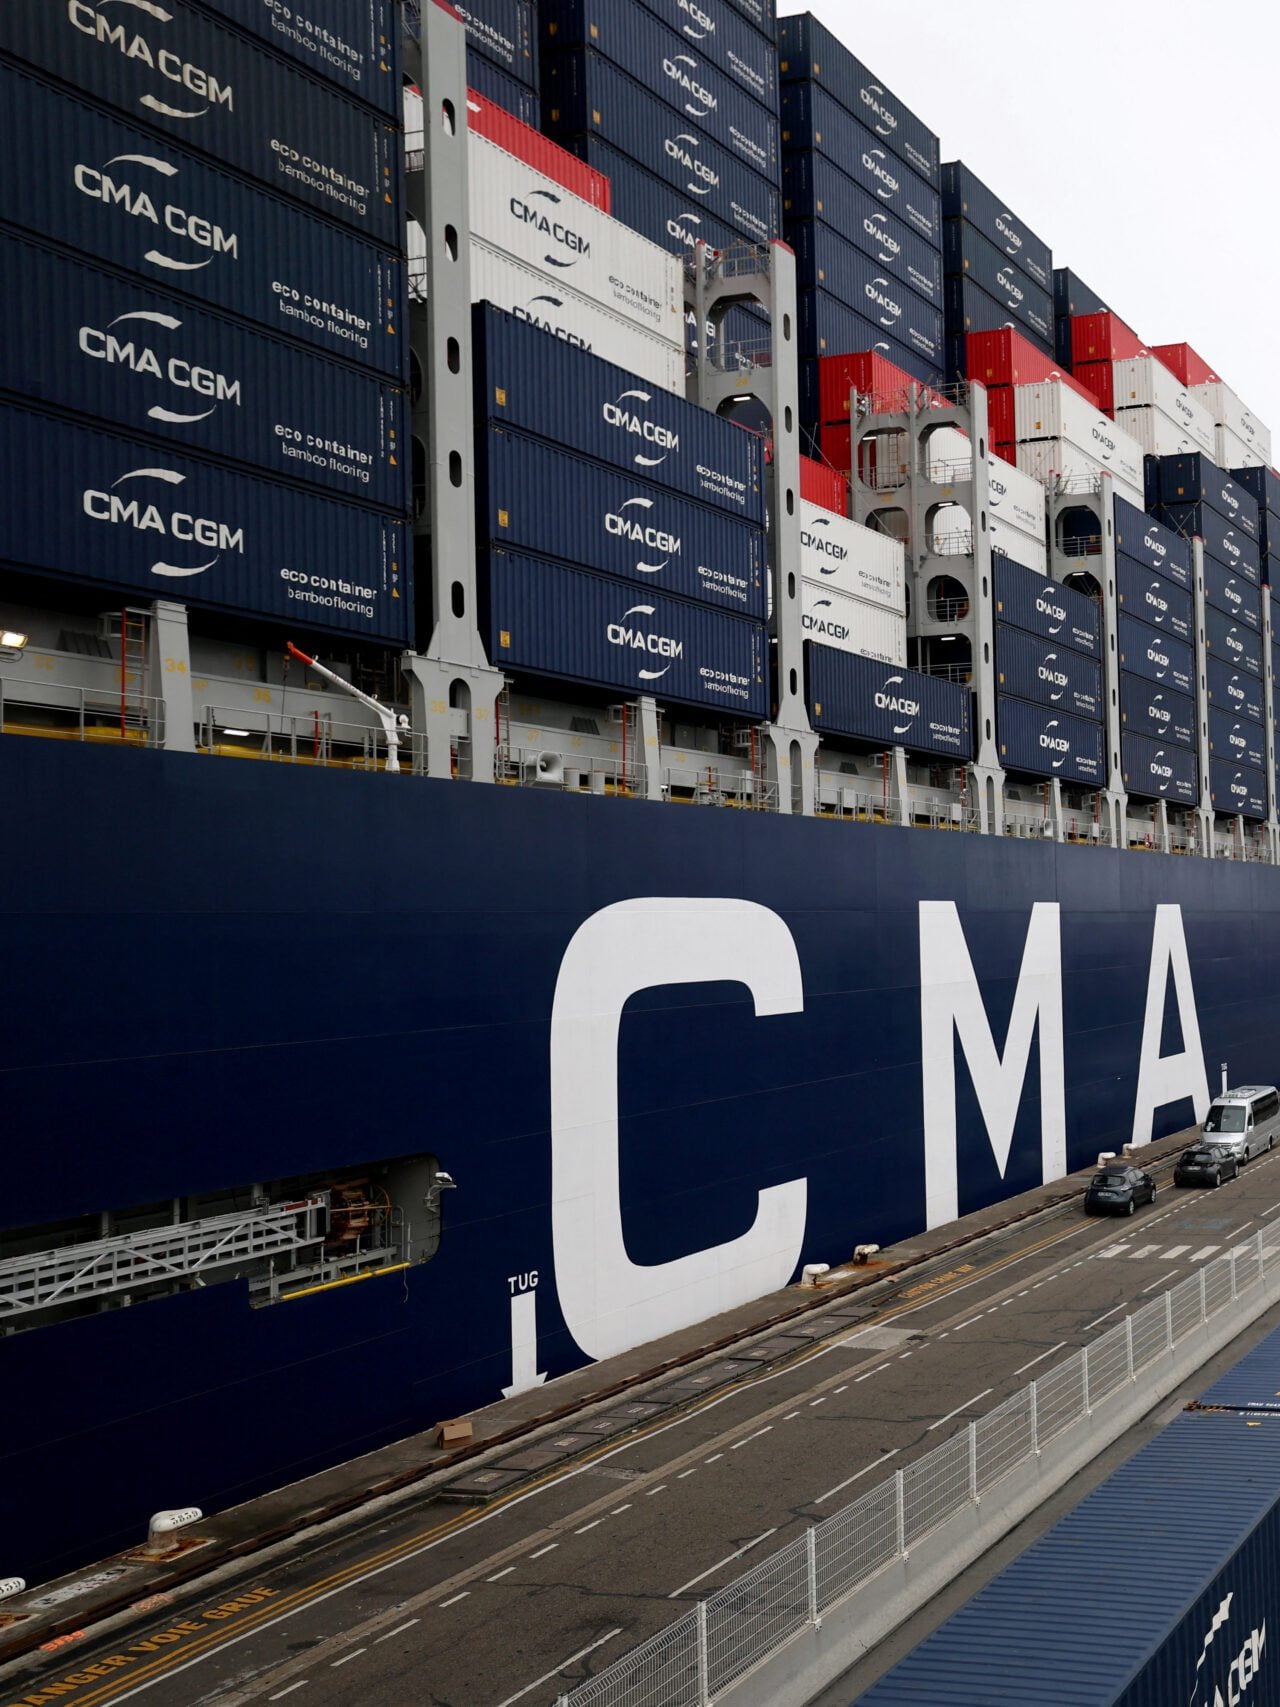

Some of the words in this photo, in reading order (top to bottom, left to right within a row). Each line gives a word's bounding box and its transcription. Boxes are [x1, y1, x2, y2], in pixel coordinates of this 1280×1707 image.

[68, 0, 154, 68] CMA
[158, 50, 233, 112] CGM
[270, 138, 299, 161] eco
[302, 155, 370, 198] container
[278, 159, 324, 193] bamboo
[325, 184, 366, 216] flooring
[74, 164, 158, 224] CMA
[165, 204, 238, 259] CGM
[510, 198, 551, 236] CMA
[553, 216, 590, 259] CGM
[272, 281, 299, 300] eco
[304, 294, 371, 332] container
[280, 300, 324, 329] bamboo
[327, 319, 367, 349] flooring
[79, 327, 162, 379] CMA
[168, 358, 241, 406] CGM
[275, 424, 301, 442] eco
[306, 436, 373, 466] container
[603, 403, 642, 436] CMA
[643, 422, 679, 453] CGM
[282, 442, 326, 467] bamboo
[329, 457, 369, 482] flooring
[83, 489, 165, 534] CMA
[171, 514, 244, 554] CGM
[605, 513, 644, 542] CMA
[645, 531, 681, 557] CGM
[801, 531, 825, 555] CMA
[826, 541, 848, 560] CGM
[281, 567, 308, 584] eco
[310, 575, 377, 599] container
[287, 586, 333, 605] bamboo
[334, 596, 374, 618] flooring
[607, 623, 646, 650] CMA
[647, 638, 683, 660] CGM
[802, 615, 826, 634] CMA
[826, 621, 849, 640] CGM
[875, 692, 898, 712] CMA
[898, 700, 920, 717] CGM
[550, 897, 1213, 1361] CMA
[508, 1271, 538, 1293] TUG
[129, 1620, 208, 1653] VOIE
[202, 1586, 280, 1620] GRUE
